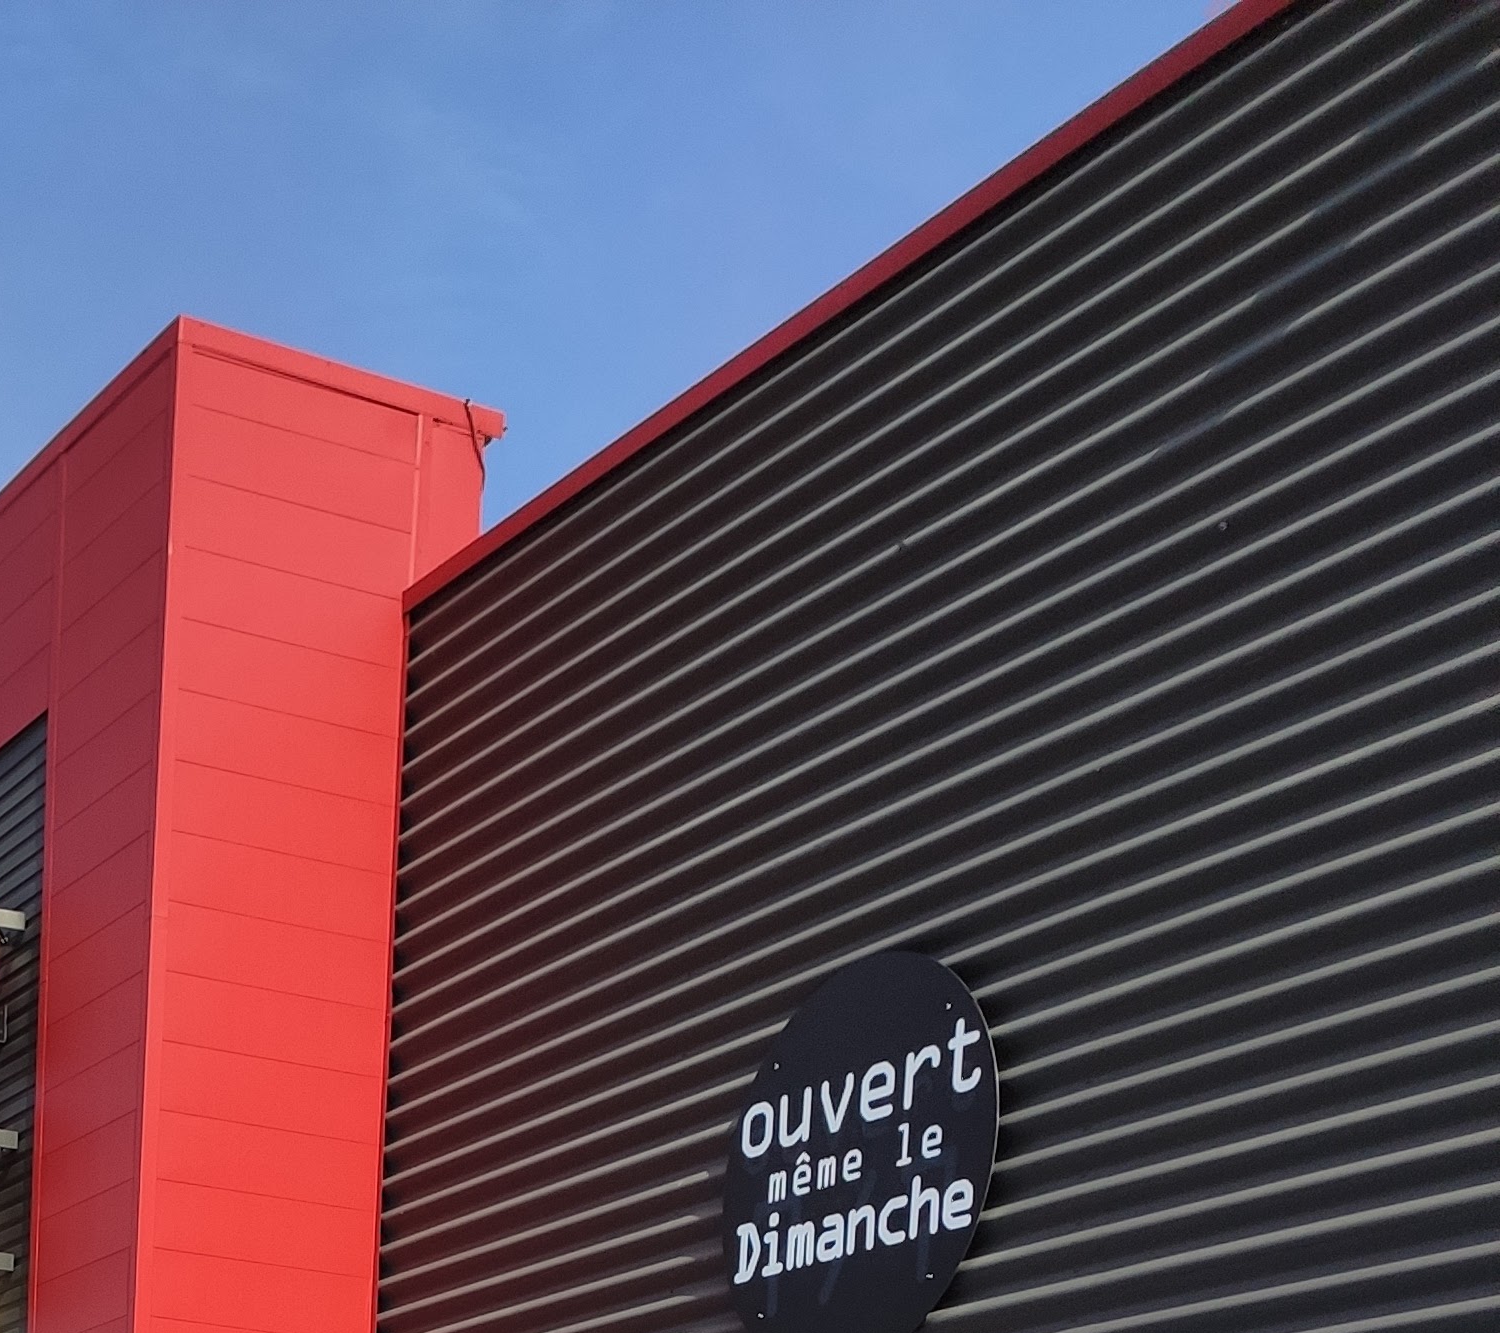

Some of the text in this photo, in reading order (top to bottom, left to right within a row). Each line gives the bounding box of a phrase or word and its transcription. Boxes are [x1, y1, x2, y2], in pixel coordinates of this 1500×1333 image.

[741, 1018, 982, 1158] ouvert
[768, 1122, 943, 1203] même le
[733, 1176, 975, 1284] Dimanche
